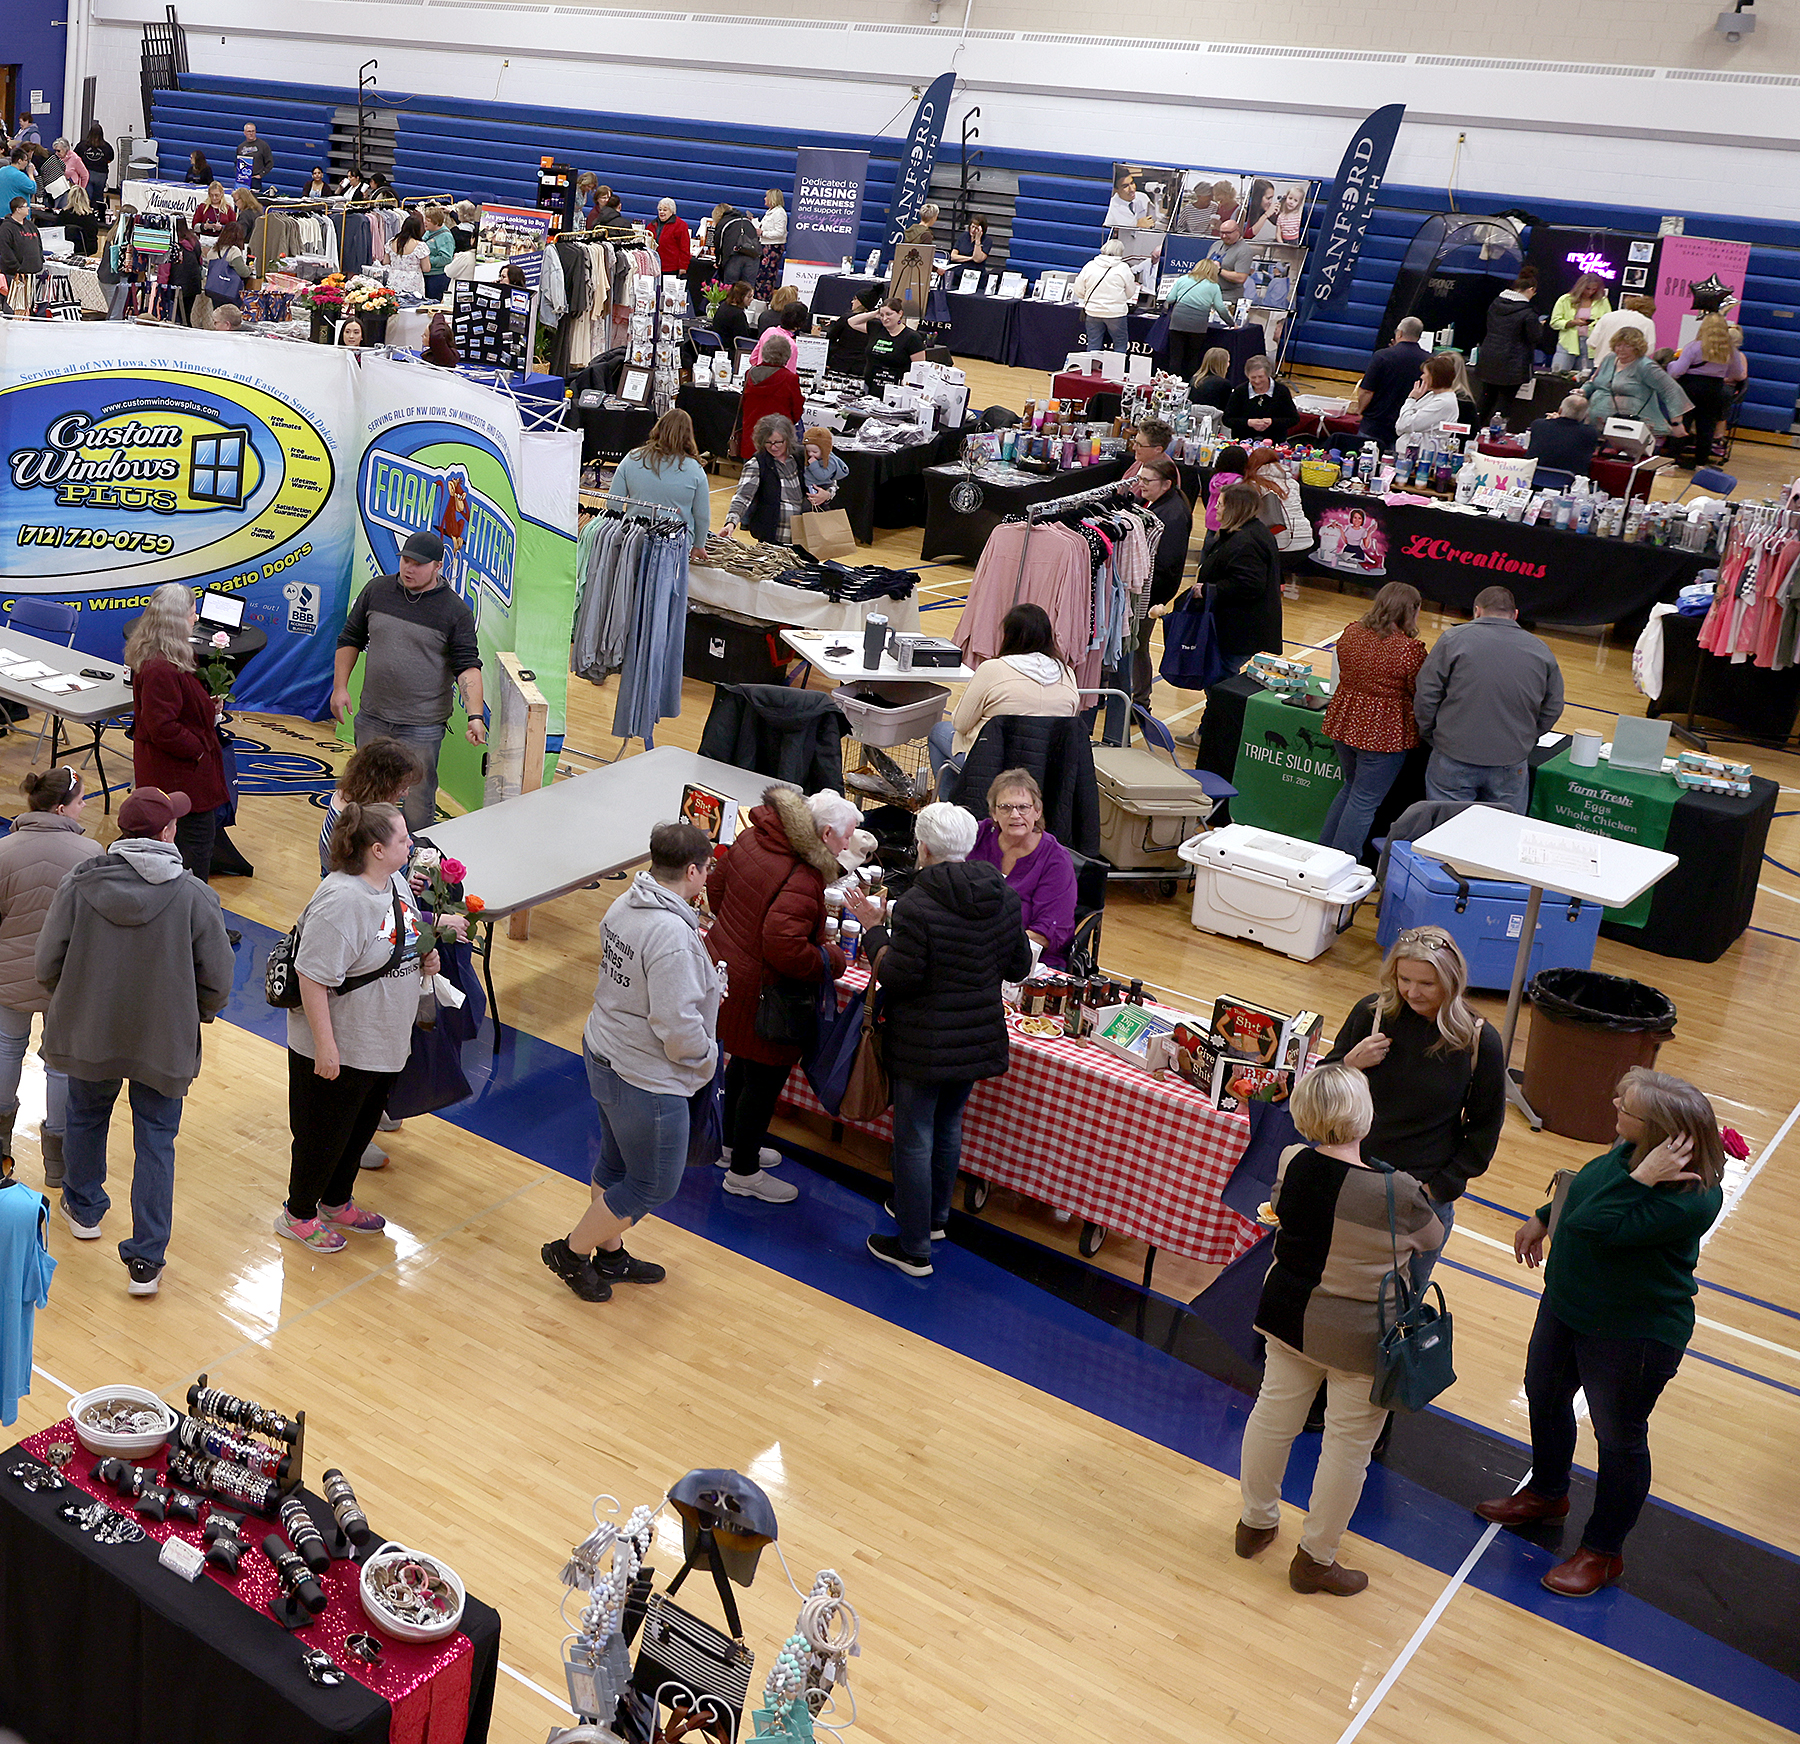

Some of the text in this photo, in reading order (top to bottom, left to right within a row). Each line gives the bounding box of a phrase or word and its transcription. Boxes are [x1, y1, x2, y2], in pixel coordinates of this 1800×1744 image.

[889, 102, 935, 245] SANFORD
[912, 135, 938, 221] HEALTH
[802, 177, 858, 188] Dedicated to
[800, 186, 857, 200] RAISING
[149, 191, 186, 212] Minnesota
[800, 198, 855, 208] AWARENESS
[798, 205, 855, 216] and support for
[506, 216, 528, 225] Looking
[1315, 137, 1374, 300] SANFORD
[1344, 175, 1381, 271] HEALTH
[795, 222, 852, 234] OF CANCER
[1170, 259, 1196, 269] SANF
[796, 272, 820, 280] SANF
[19, 358, 338, 450] Serving all of NW Iowa, SW Minnesota, and Eastern South Dakota
[101, 398, 220, 417] www.customwindowsplus.com
[271, 421, 302, 430] Estimates
[368, 412, 393, 433] SERVING
[394, 408, 405, 419] ALL
[406, 407, 415, 417] OF
[416, 407, 428, 416] NW
[429, 406, 448, 418] IOWA,
[448, 408, 458, 418] SW
[48, 412, 180, 451] Custom
[290, 453, 321, 462] Installation
[10, 450, 178, 487] Windows
[291, 477, 318, 486] Lifetime
[291, 482, 323, 493] Warranty
[57, 482, 178, 513] PLUS
[374, 462, 438, 532] FOAM
[273, 509, 308, 519] Guaranteed
[276, 504, 312, 514] Satisfaction
[250, 531, 275, 540] Owned!
[254, 527, 275, 535] Family
[18, 524, 174, 554] (712) 720-0759
[466, 501, 513, 591] FITTERS
[1401, 535, 1547, 579] LCreations
[88, 596, 152, 611] Windo
[209, 570, 259, 594] Patio
[262, 542, 313, 577] Doors
[262, 602, 280, 611] out!
[249, 612, 279, 627] oogle
[292, 610, 314, 623] BBB
[1244, 742, 1342, 780] TRIPLE SILO MEA
[1282, 773, 1311, 788] EST. 2022
[1567, 781, 1634, 807] Farm Fresh:
[1584, 799, 1612, 814] Eggs
[1555, 805, 1638, 834] Whole Chicken
[1196, 1045, 1215, 1063] Give
